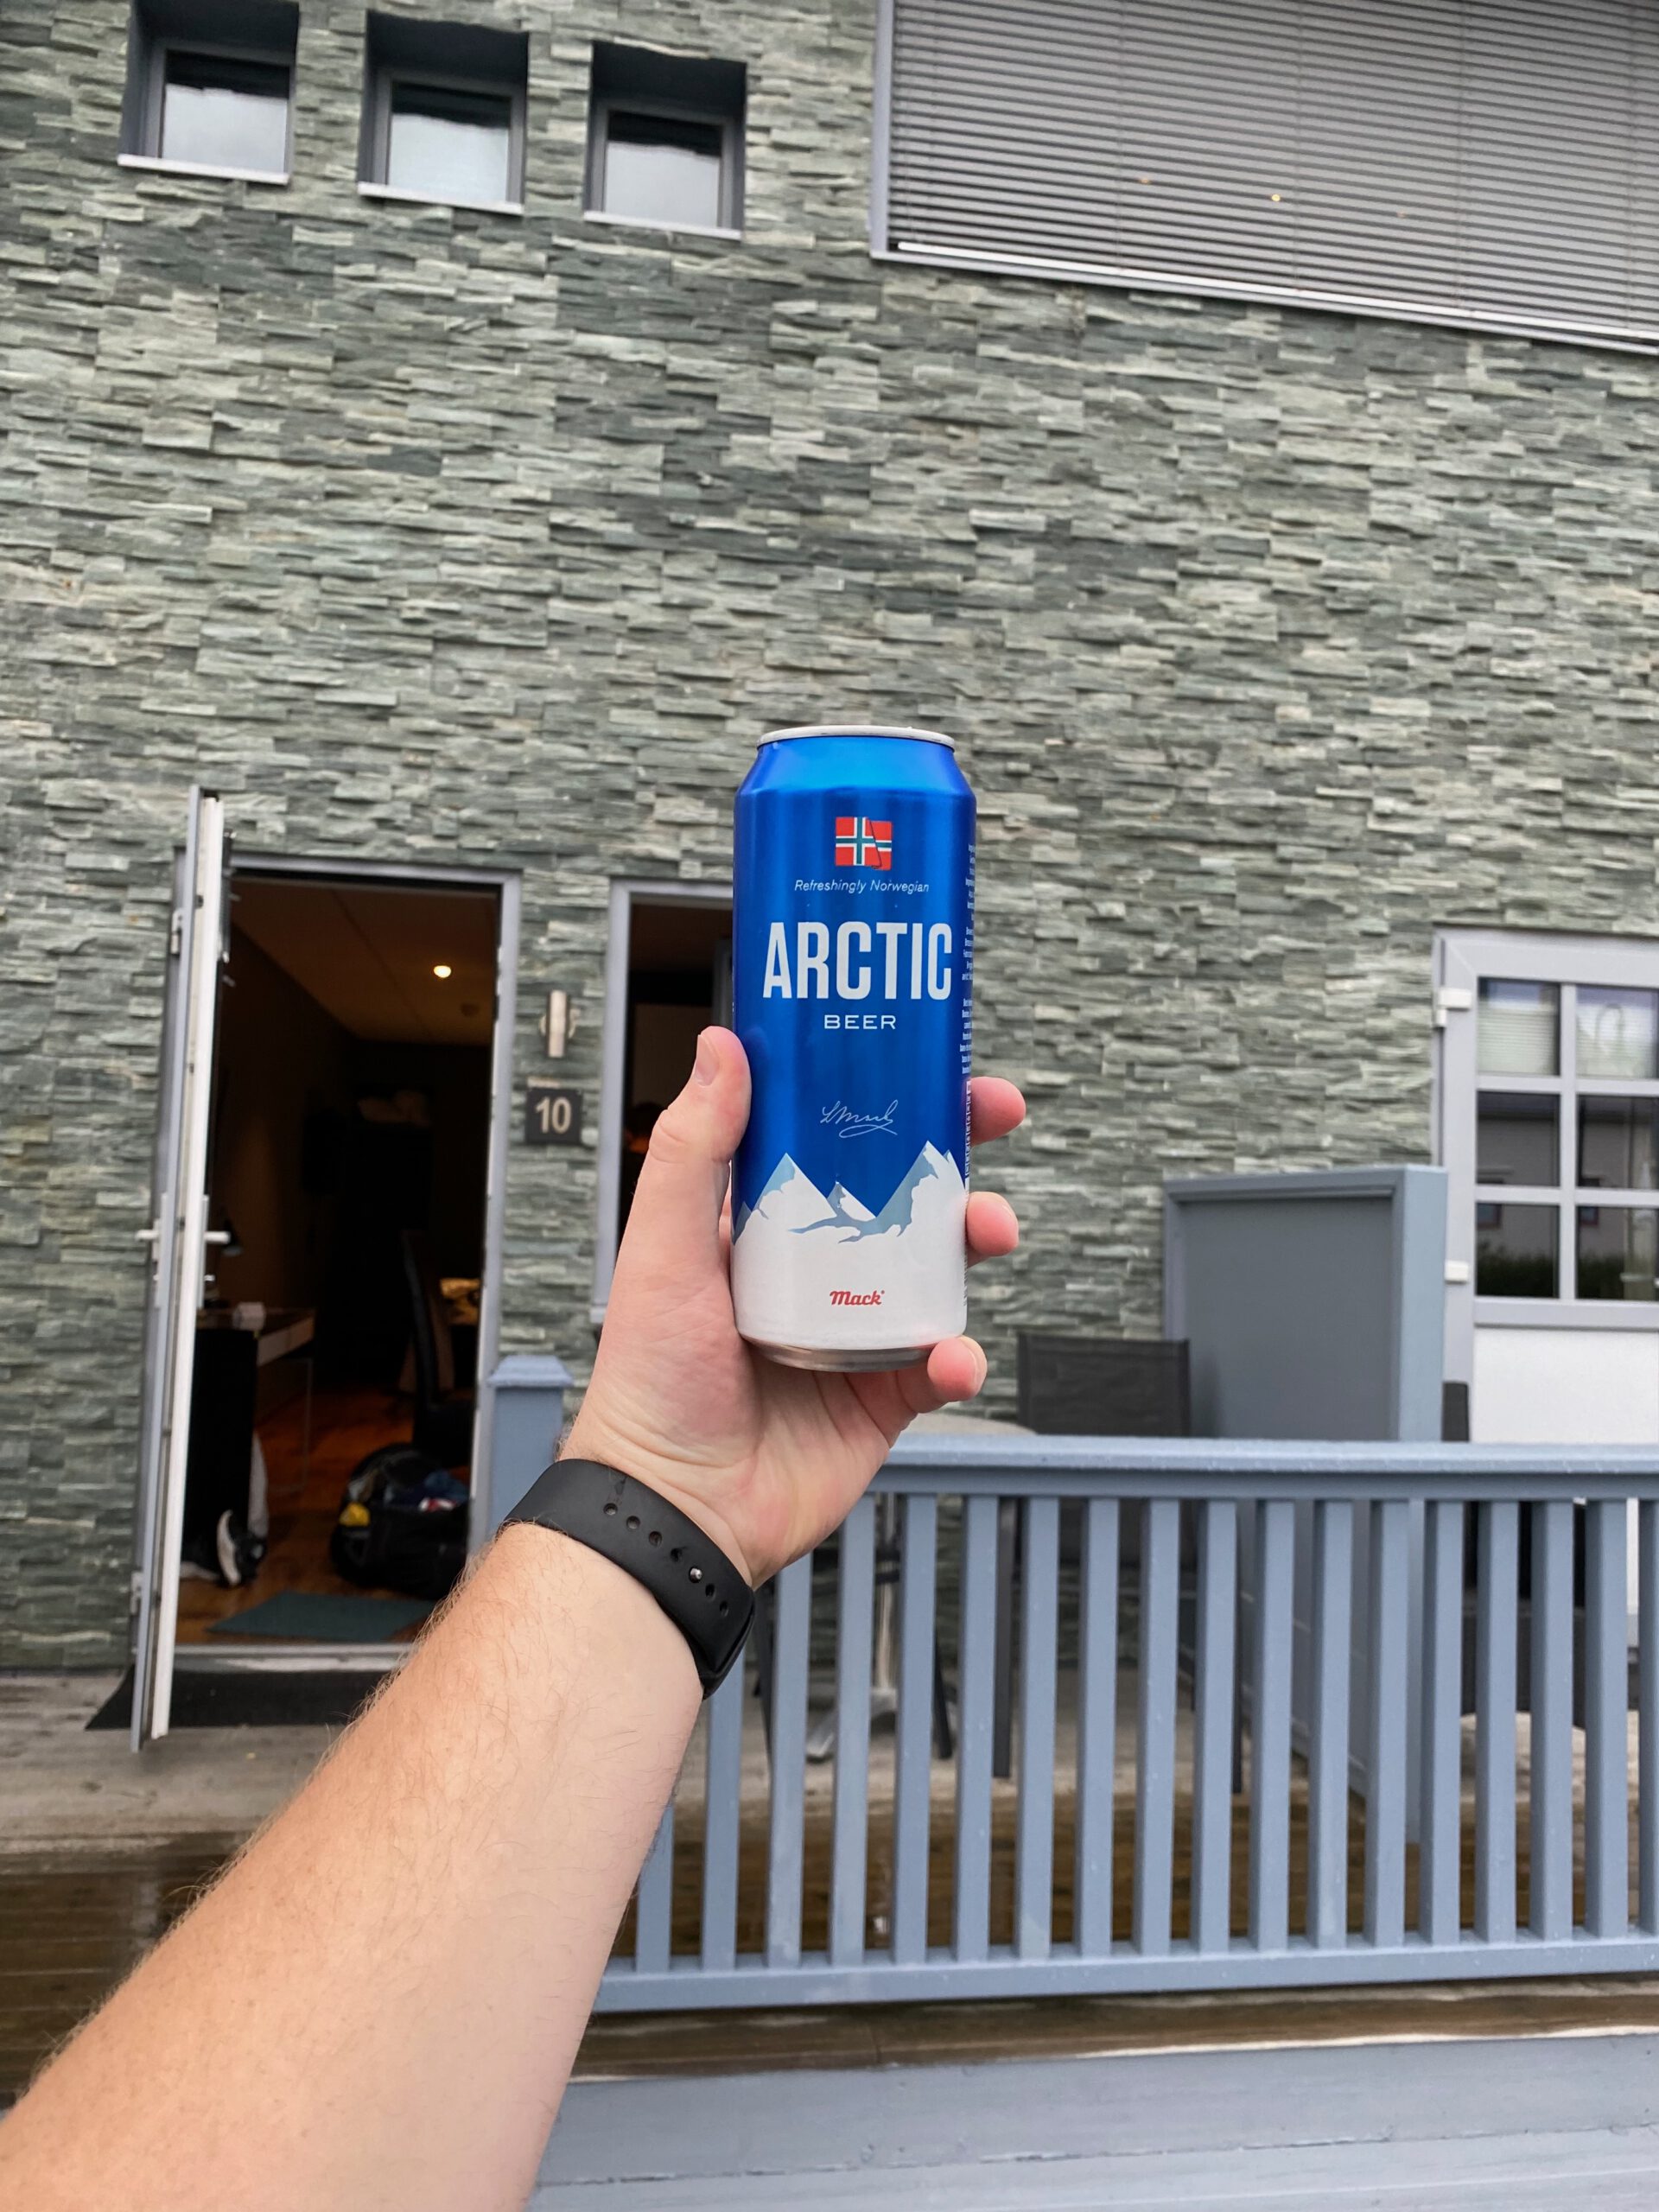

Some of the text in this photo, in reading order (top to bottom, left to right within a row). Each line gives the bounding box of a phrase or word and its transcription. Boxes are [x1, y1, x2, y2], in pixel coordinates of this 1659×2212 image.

[794, 879, 930, 895] Refreshingly Norwegian
[762, 921, 952, 1001] ARCTIC
[823, 1014, 897, 1030] BEER
[535, 1096, 571, 1134] 10
